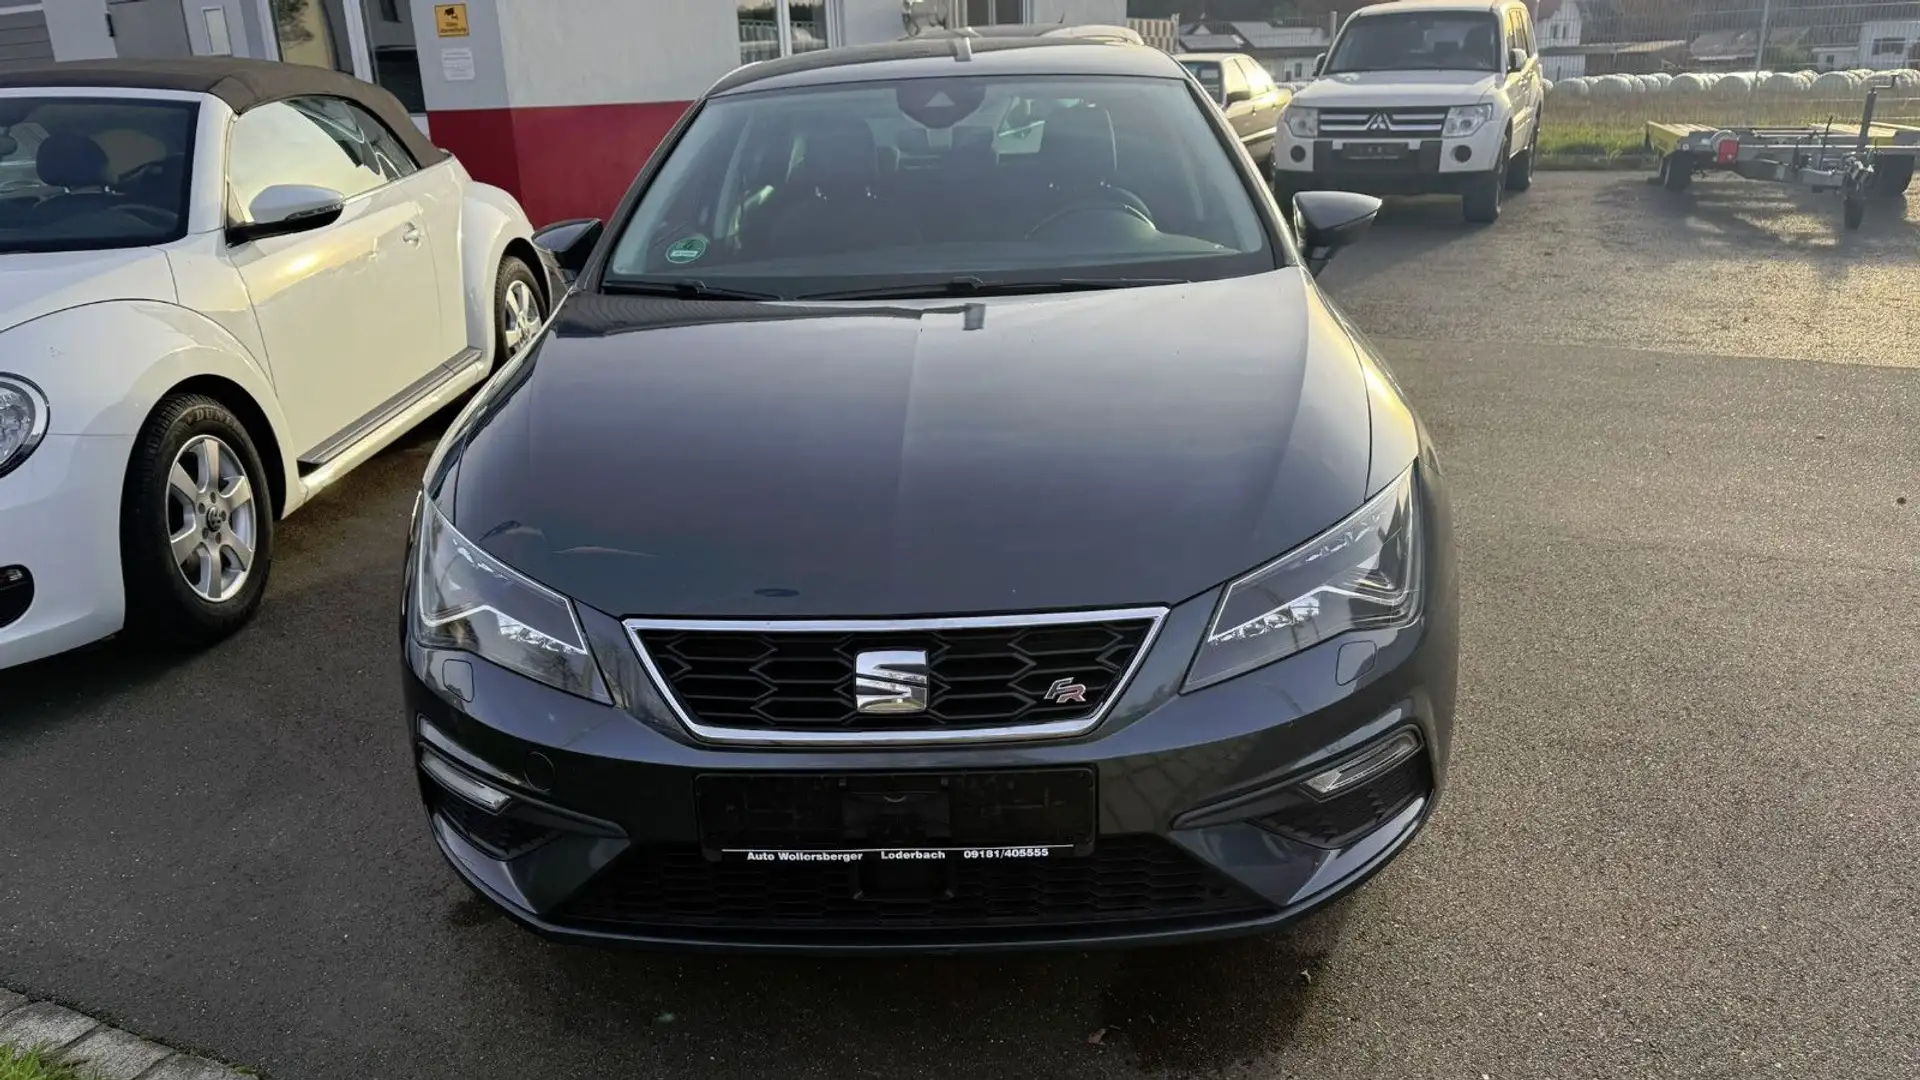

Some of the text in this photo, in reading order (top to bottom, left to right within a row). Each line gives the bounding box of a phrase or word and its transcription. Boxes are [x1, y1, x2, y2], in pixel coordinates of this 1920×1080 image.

[1043, 676, 1087, 704] FR
[747, 851, 775, 861] Auto
[881, 850, 946, 860] Loderbach
[963, 847, 1049, 860] 09181/405555
